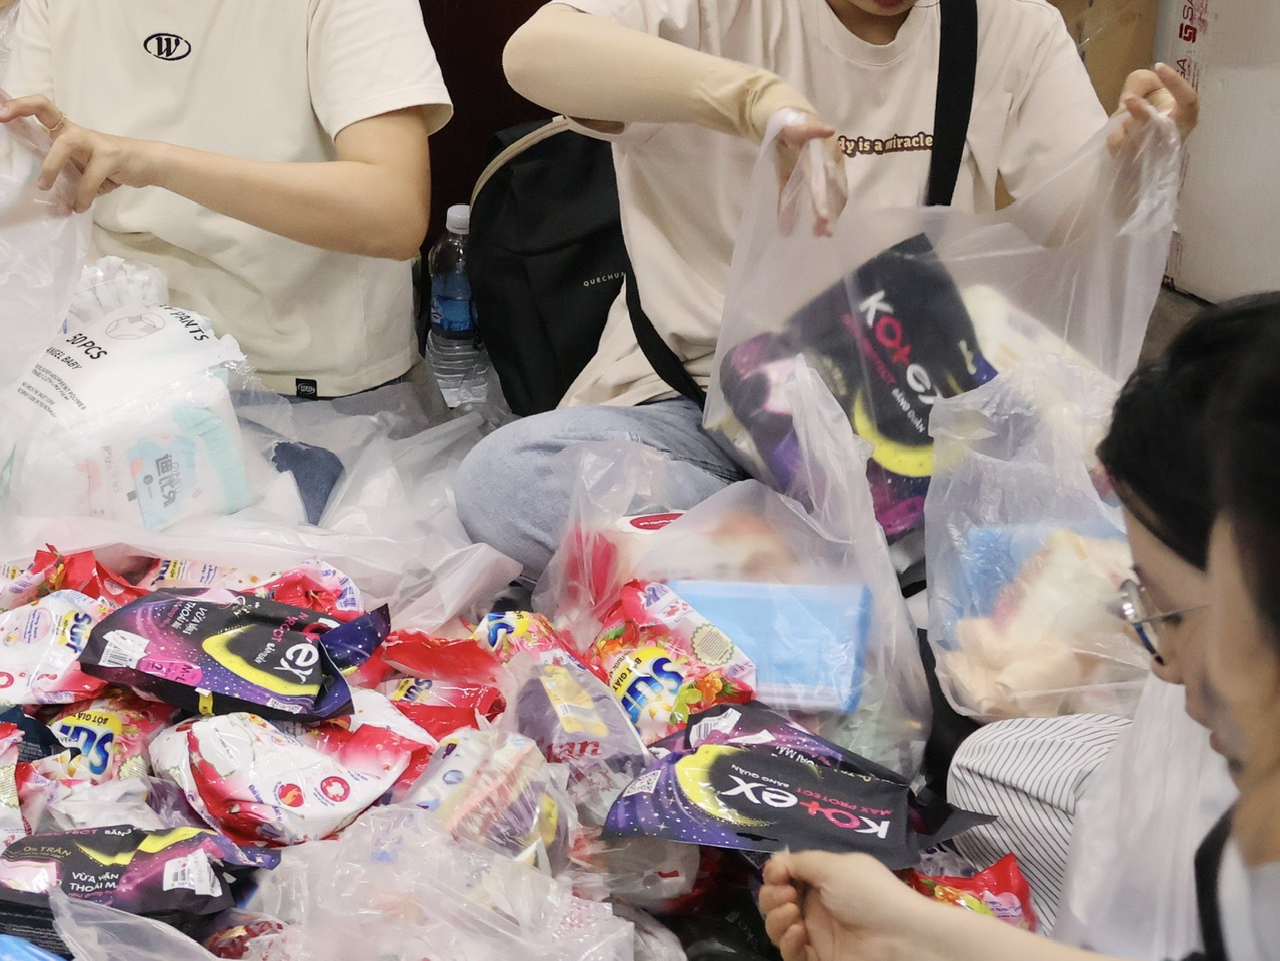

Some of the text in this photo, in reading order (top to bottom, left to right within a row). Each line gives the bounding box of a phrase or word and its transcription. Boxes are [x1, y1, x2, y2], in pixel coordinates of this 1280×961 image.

[858, 137, 871, 152] is
[884, 133, 934, 151] miracle
[170, 311, 210, 342] PANTS
